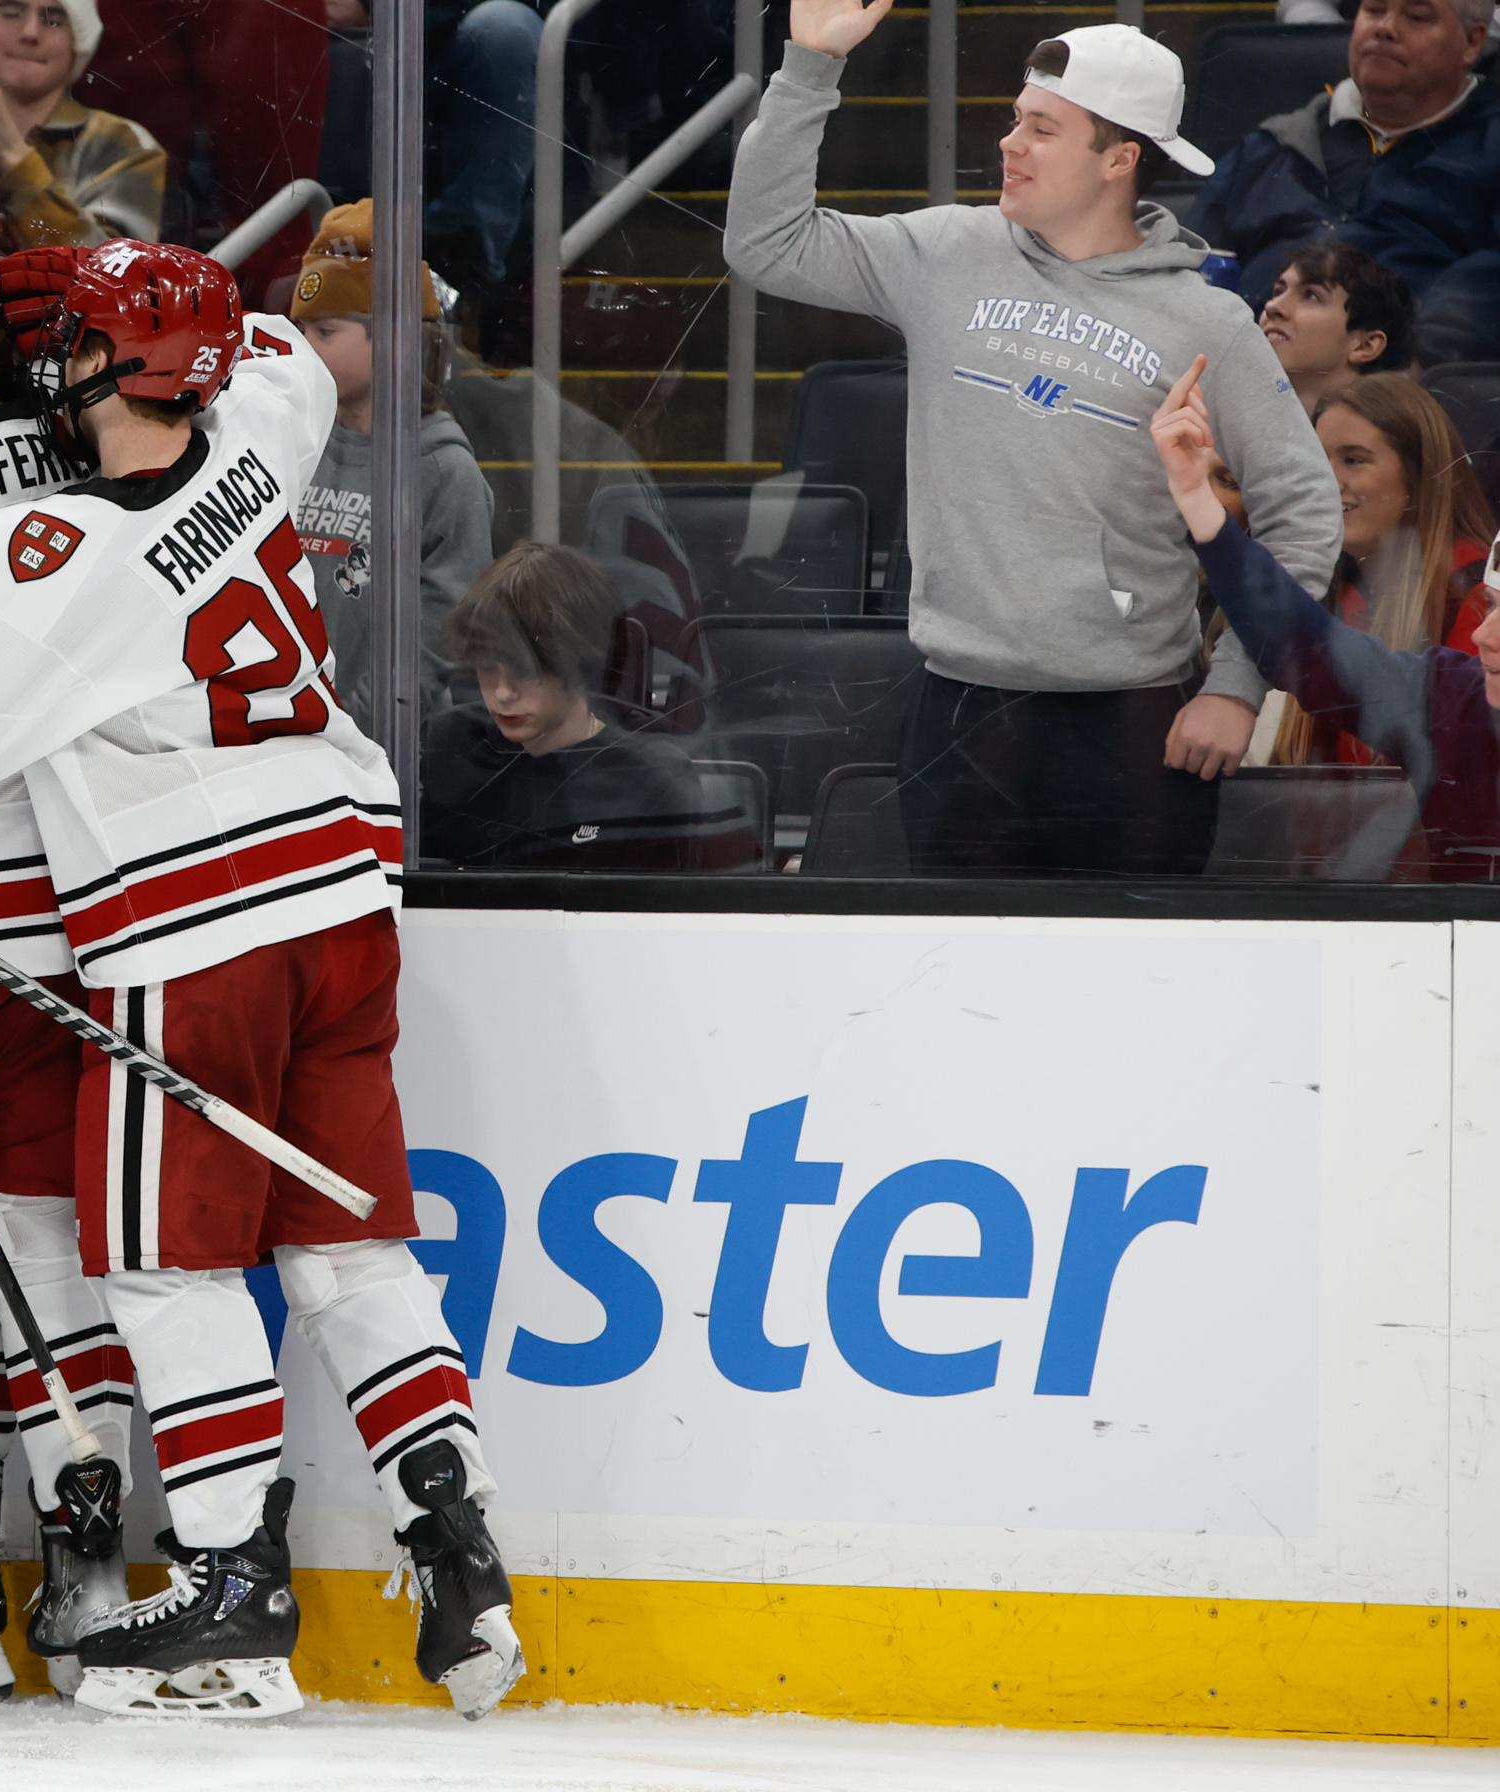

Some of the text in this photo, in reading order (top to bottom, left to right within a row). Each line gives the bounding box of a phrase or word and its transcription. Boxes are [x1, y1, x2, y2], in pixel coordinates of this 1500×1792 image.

[103, 246, 141, 278] H
[191, 345, 222, 372] 25
[964, 297, 1163, 387] NOR'EASTERS
[986, 336, 1125, 388] BASEBALL
[1020, 374, 1071, 409] NE
[144, 448, 282, 596] FARINACCI
[23, 550, 42, 565] TAS
[577, 824, 598, 838] NIKE
